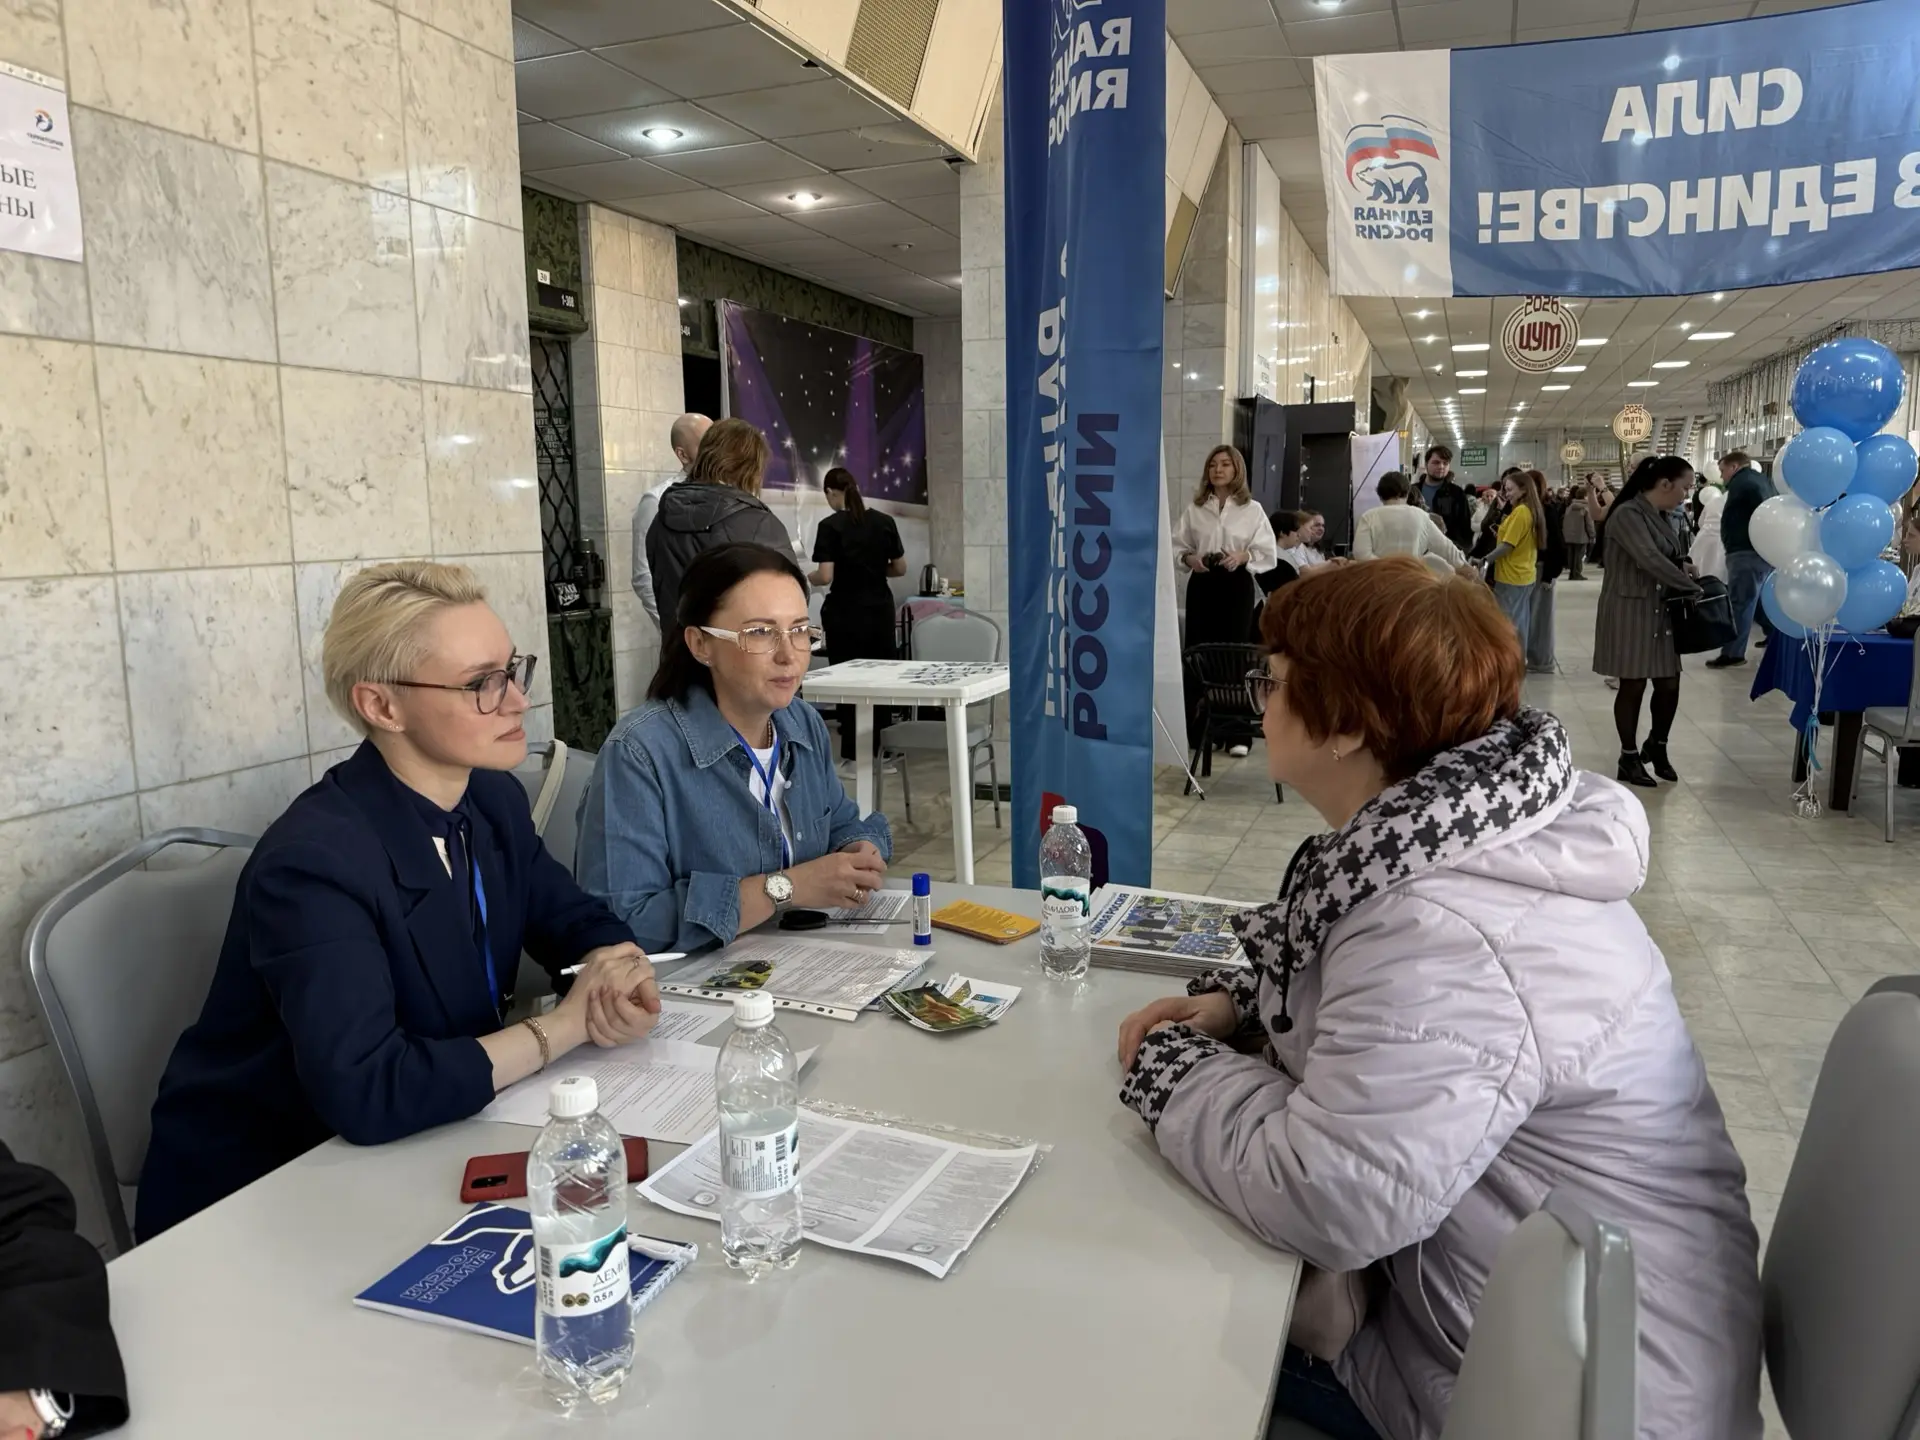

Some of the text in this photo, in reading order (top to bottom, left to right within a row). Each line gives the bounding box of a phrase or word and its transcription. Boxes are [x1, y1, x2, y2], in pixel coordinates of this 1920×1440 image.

[1524, 296, 1560, 316] 2026
[399, 1245, 480, 1301] РОССИЯ
[417, 1249, 497, 1304] ЕДИНАЯ
